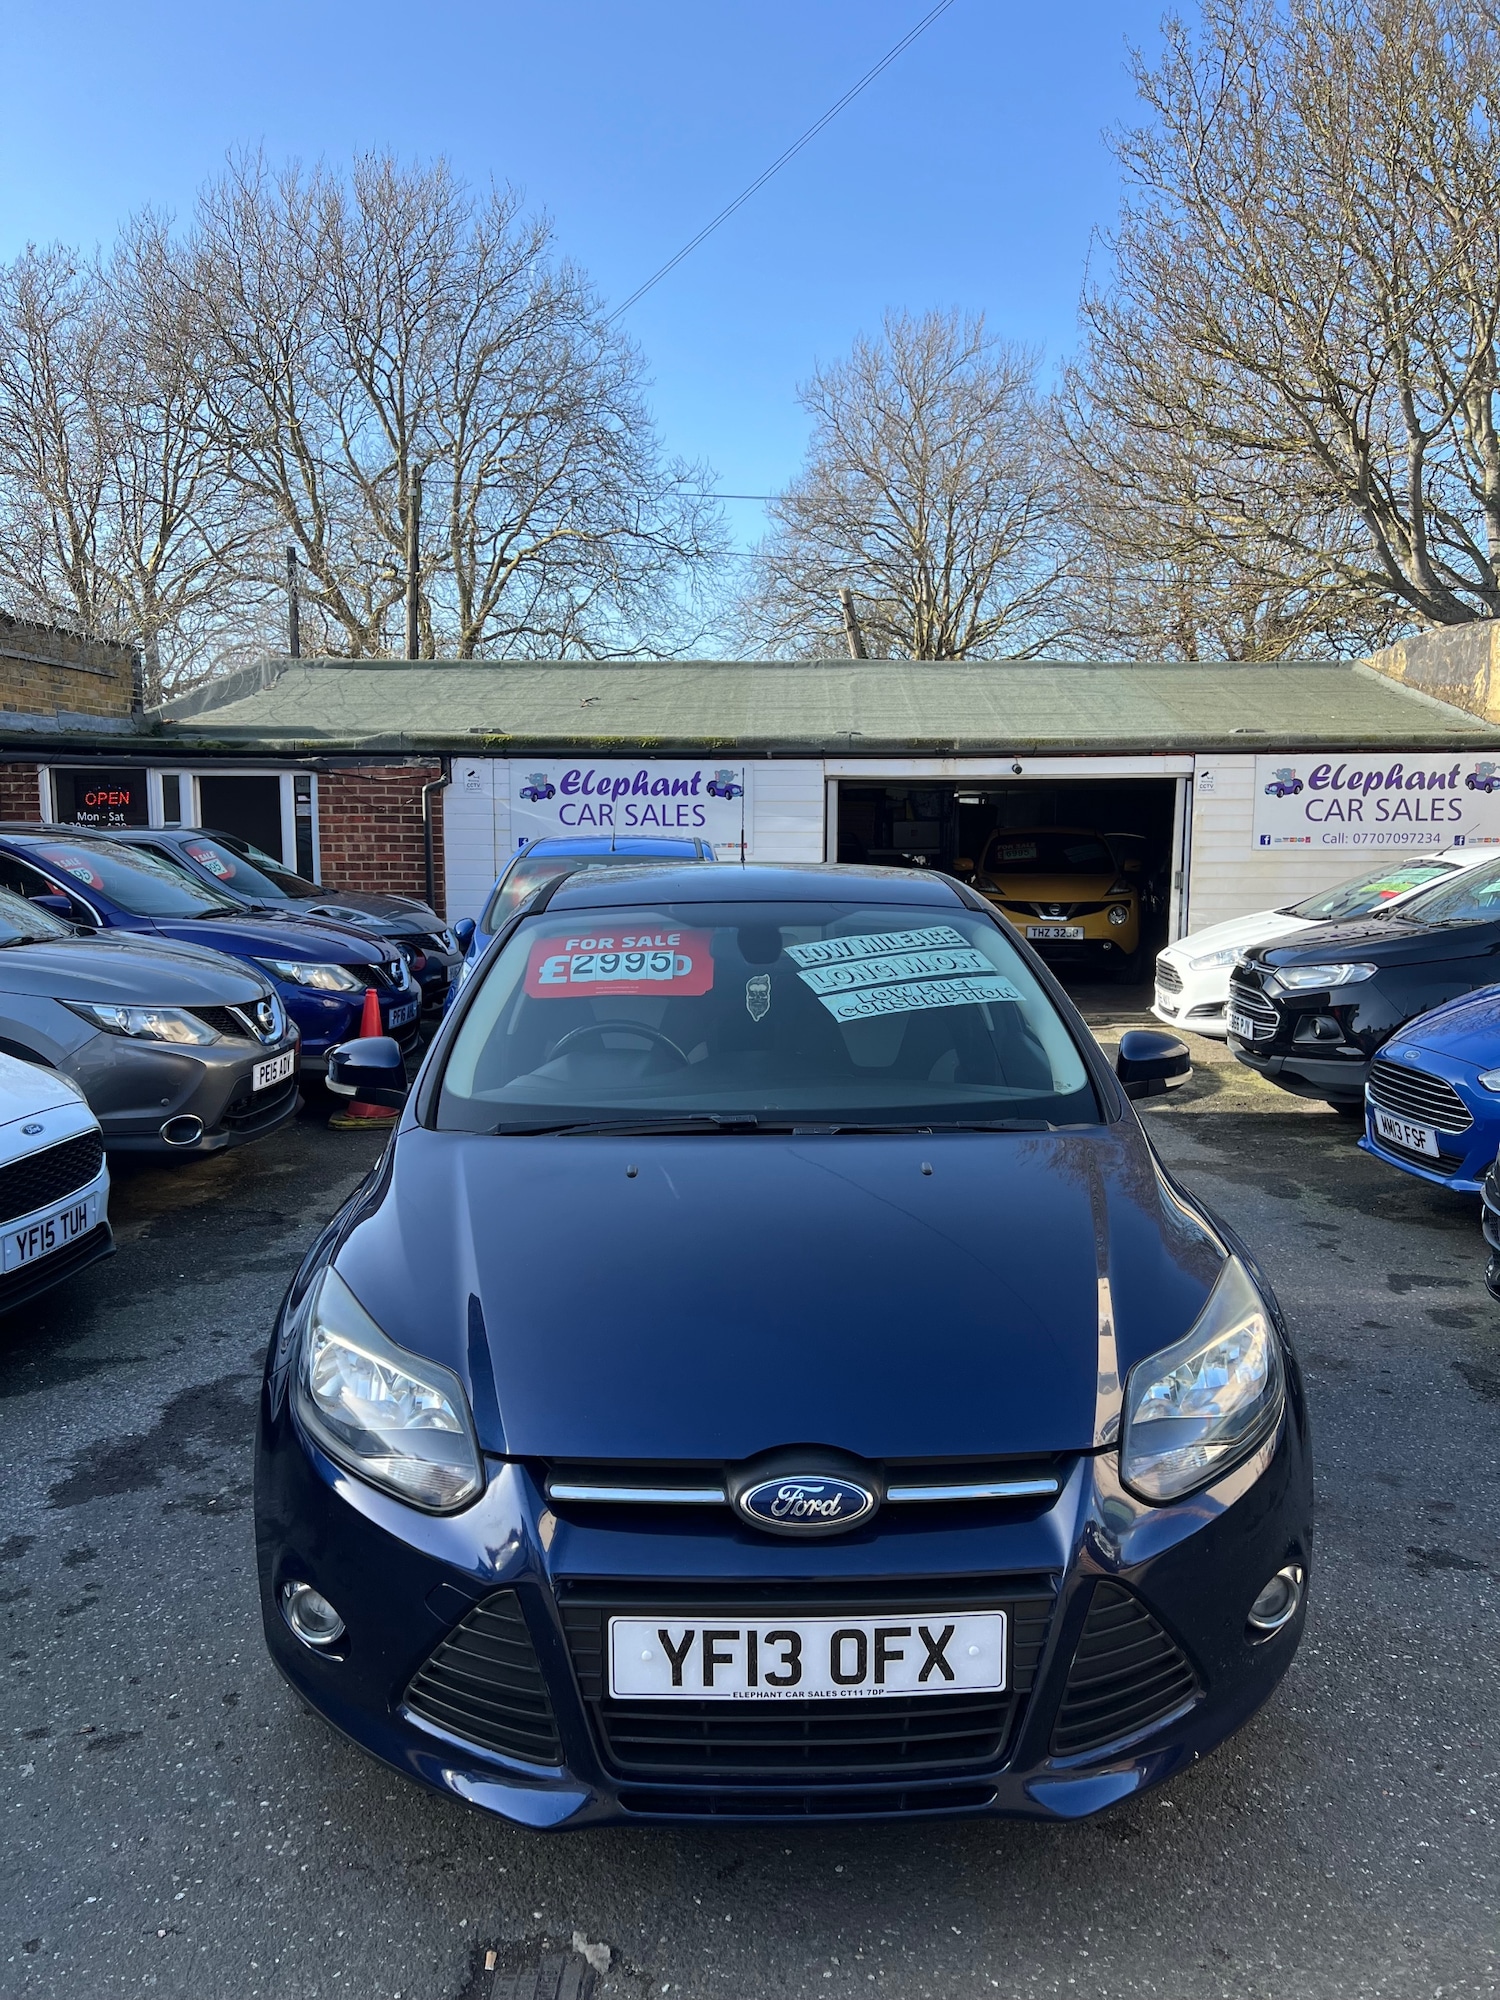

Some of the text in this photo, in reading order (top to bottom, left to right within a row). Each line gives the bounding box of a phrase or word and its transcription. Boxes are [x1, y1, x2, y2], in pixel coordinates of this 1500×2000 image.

[559, 769, 703, 802] Elephant
[1308, 763, 1461, 797] Elephant
[85, 791, 130, 806] OPEN
[1305, 798, 1463, 822] CAR SALES
[77, 811, 100, 821] Mon
[109, 811, 124, 821] Sat
[559, 803, 706, 827] CAR SALES
[1322, 832, 1349, 844] Call:
[1352, 832, 1441, 844] 07707097234
[565, 933, 681, 951] FOR SALE
[1032, 928, 1050, 938] THZ
[798, 928, 964, 963] LOW MILEAGE
[807, 962, 898, 989] LONG
[837, 987, 1019, 1018] CONSUMPTION
[856, 979, 983, 1003] LOW FUEL
[260, 1061, 277, 1085] PE15
[1403, 1124, 1426, 1149] FSF
[16, 1202, 87, 1261] YF15 TUH
[771, 1484, 843, 1518] Ford
[657, 1624, 956, 1688] YF13 OFX
[732, 1691, 783, 1699] ELEPHANT
[808, 1690, 837, 1698] SALES
[840, 1689, 863, 1697] CT11
[867, 1688, 885, 1696] 7DP
